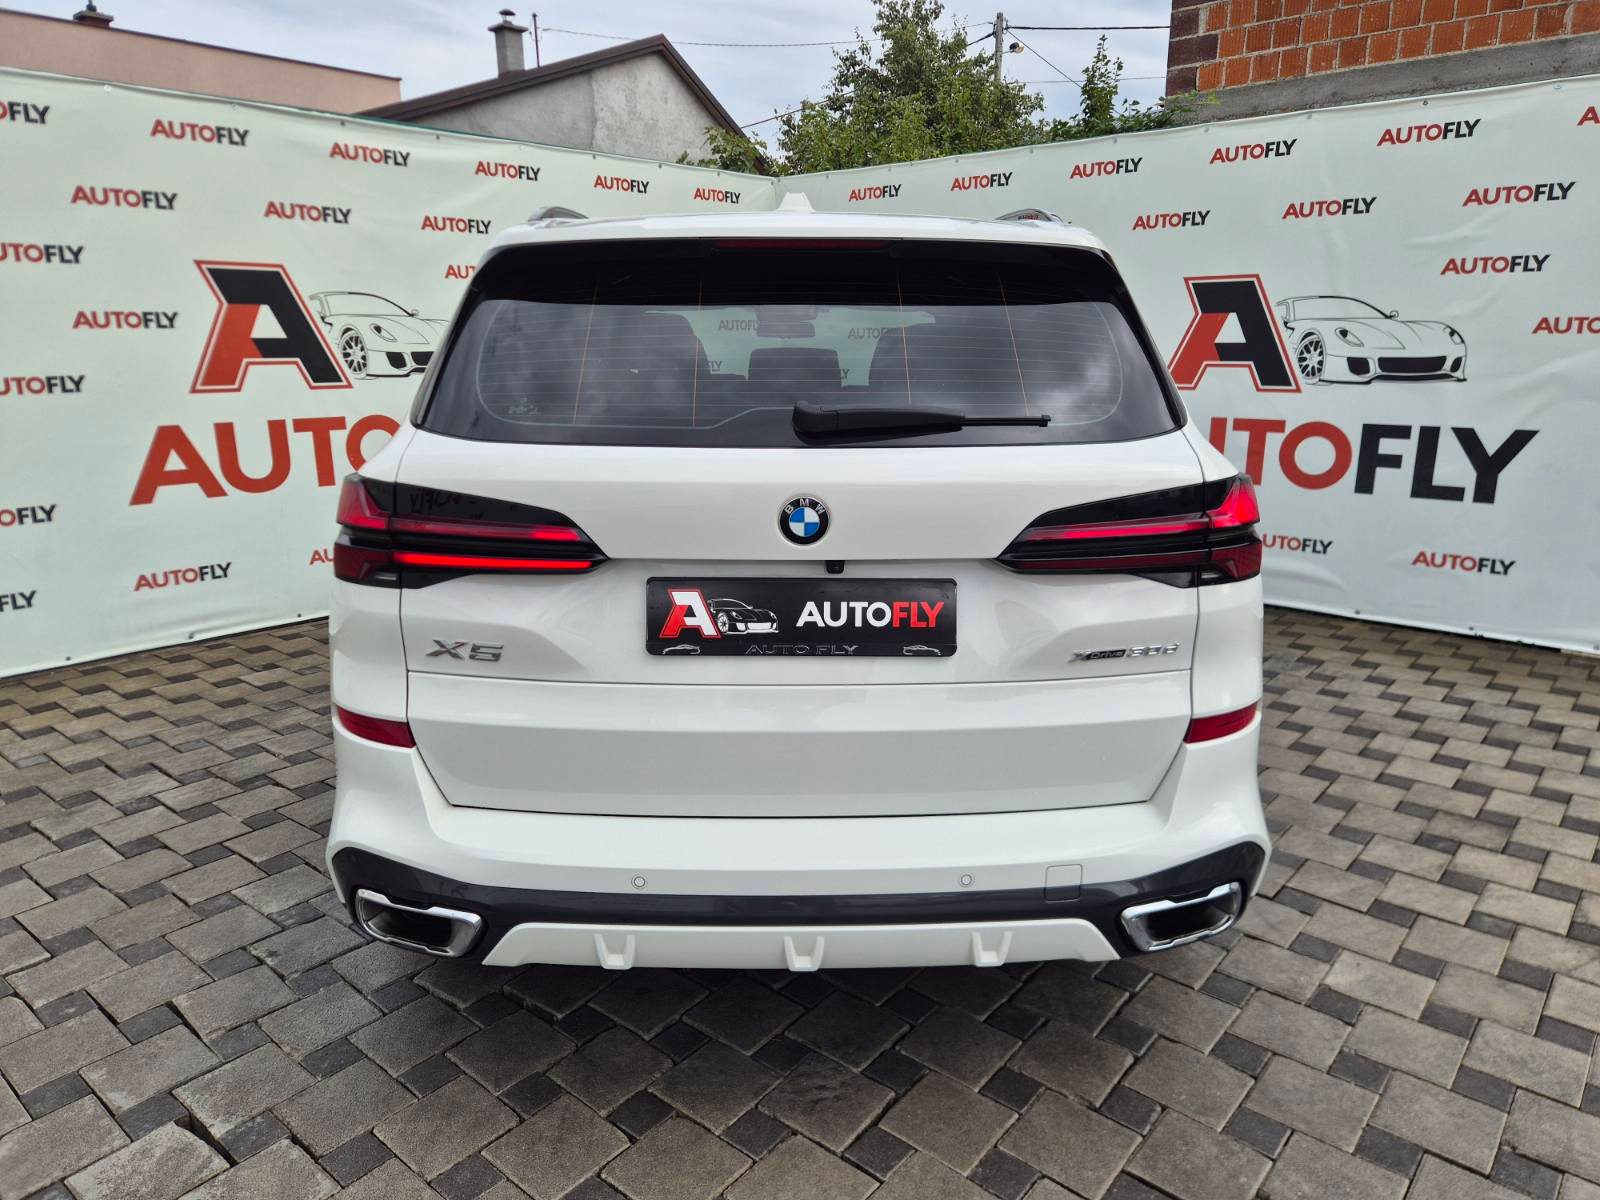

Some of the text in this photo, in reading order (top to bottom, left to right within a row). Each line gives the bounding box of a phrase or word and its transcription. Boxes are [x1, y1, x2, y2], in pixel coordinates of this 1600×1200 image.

[150, 119, 250, 147] AUTOFLY
[1376, 118, 1482, 147] AUTOFLY
[329, 142, 411, 168] AUTOFLY
[1209, 138, 1298, 165] AUTOFLY
[474, 160, 541, 182] AUTOFLY
[1069, 157, 1143, 180] AUTOFLY
[593, 174, 650, 194] AUTOFLY
[848, 183, 902, 203] AUTOFLY
[950, 171, 1014, 192] AUTOFLY
[70, 185, 178, 211] AUTOFLY
[693, 187, 742, 205] AUTOFLY
[1462, 181, 1577, 208] AUTOFLY
[263, 200, 352, 225] AUTOFLY
[1282, 196, 1378, 220] AUTOFLY
[420, 215, 492, 235] AUTOFLY
[1132, 209, 1211, 231] AUTOFLY
[1440, 254, 1552, 276] AUTOFLY
[72, 310, 179, 330] AUTOFLY
[784, 498, 825, 514] BMW
[1261, 533, 1333, 555] UTOFLY
[1411, 550, 1516, 576] AUTOFLY
[134, 561, 232, 592] AUTOFLY
[795, 600, 945, 629] AUTOFLY
[425, 639, 504, 662] X5
[745, 644, 859, 655] AUTO FLY
